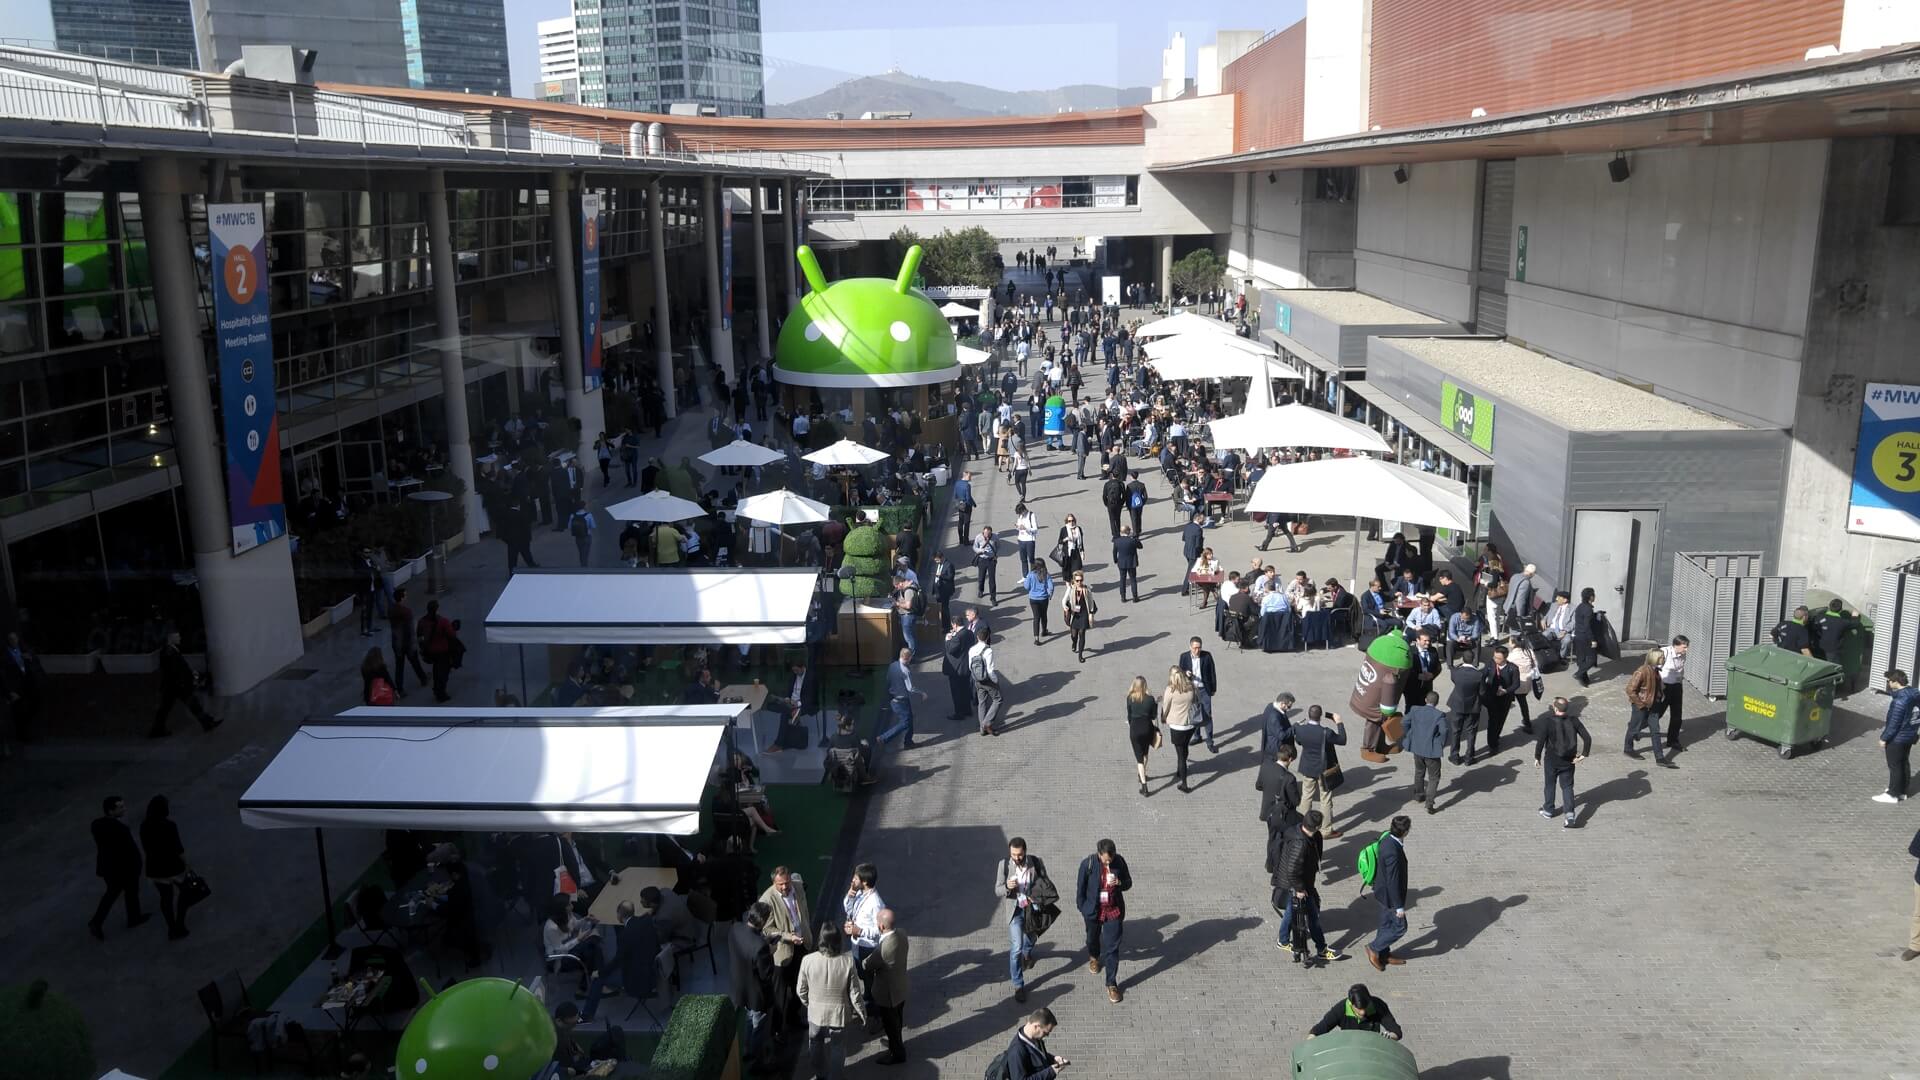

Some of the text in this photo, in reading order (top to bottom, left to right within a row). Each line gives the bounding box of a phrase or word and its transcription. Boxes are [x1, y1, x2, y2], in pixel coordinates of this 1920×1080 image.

[215, 212, 256, 227] #MWC16
[235, 264, 248, 294] 2
[220, 313, 268, 330] Hospitality Suites
[224, 333, 267, 349] Meeting Rooms
[1896, 452, 1917, 482] 3
